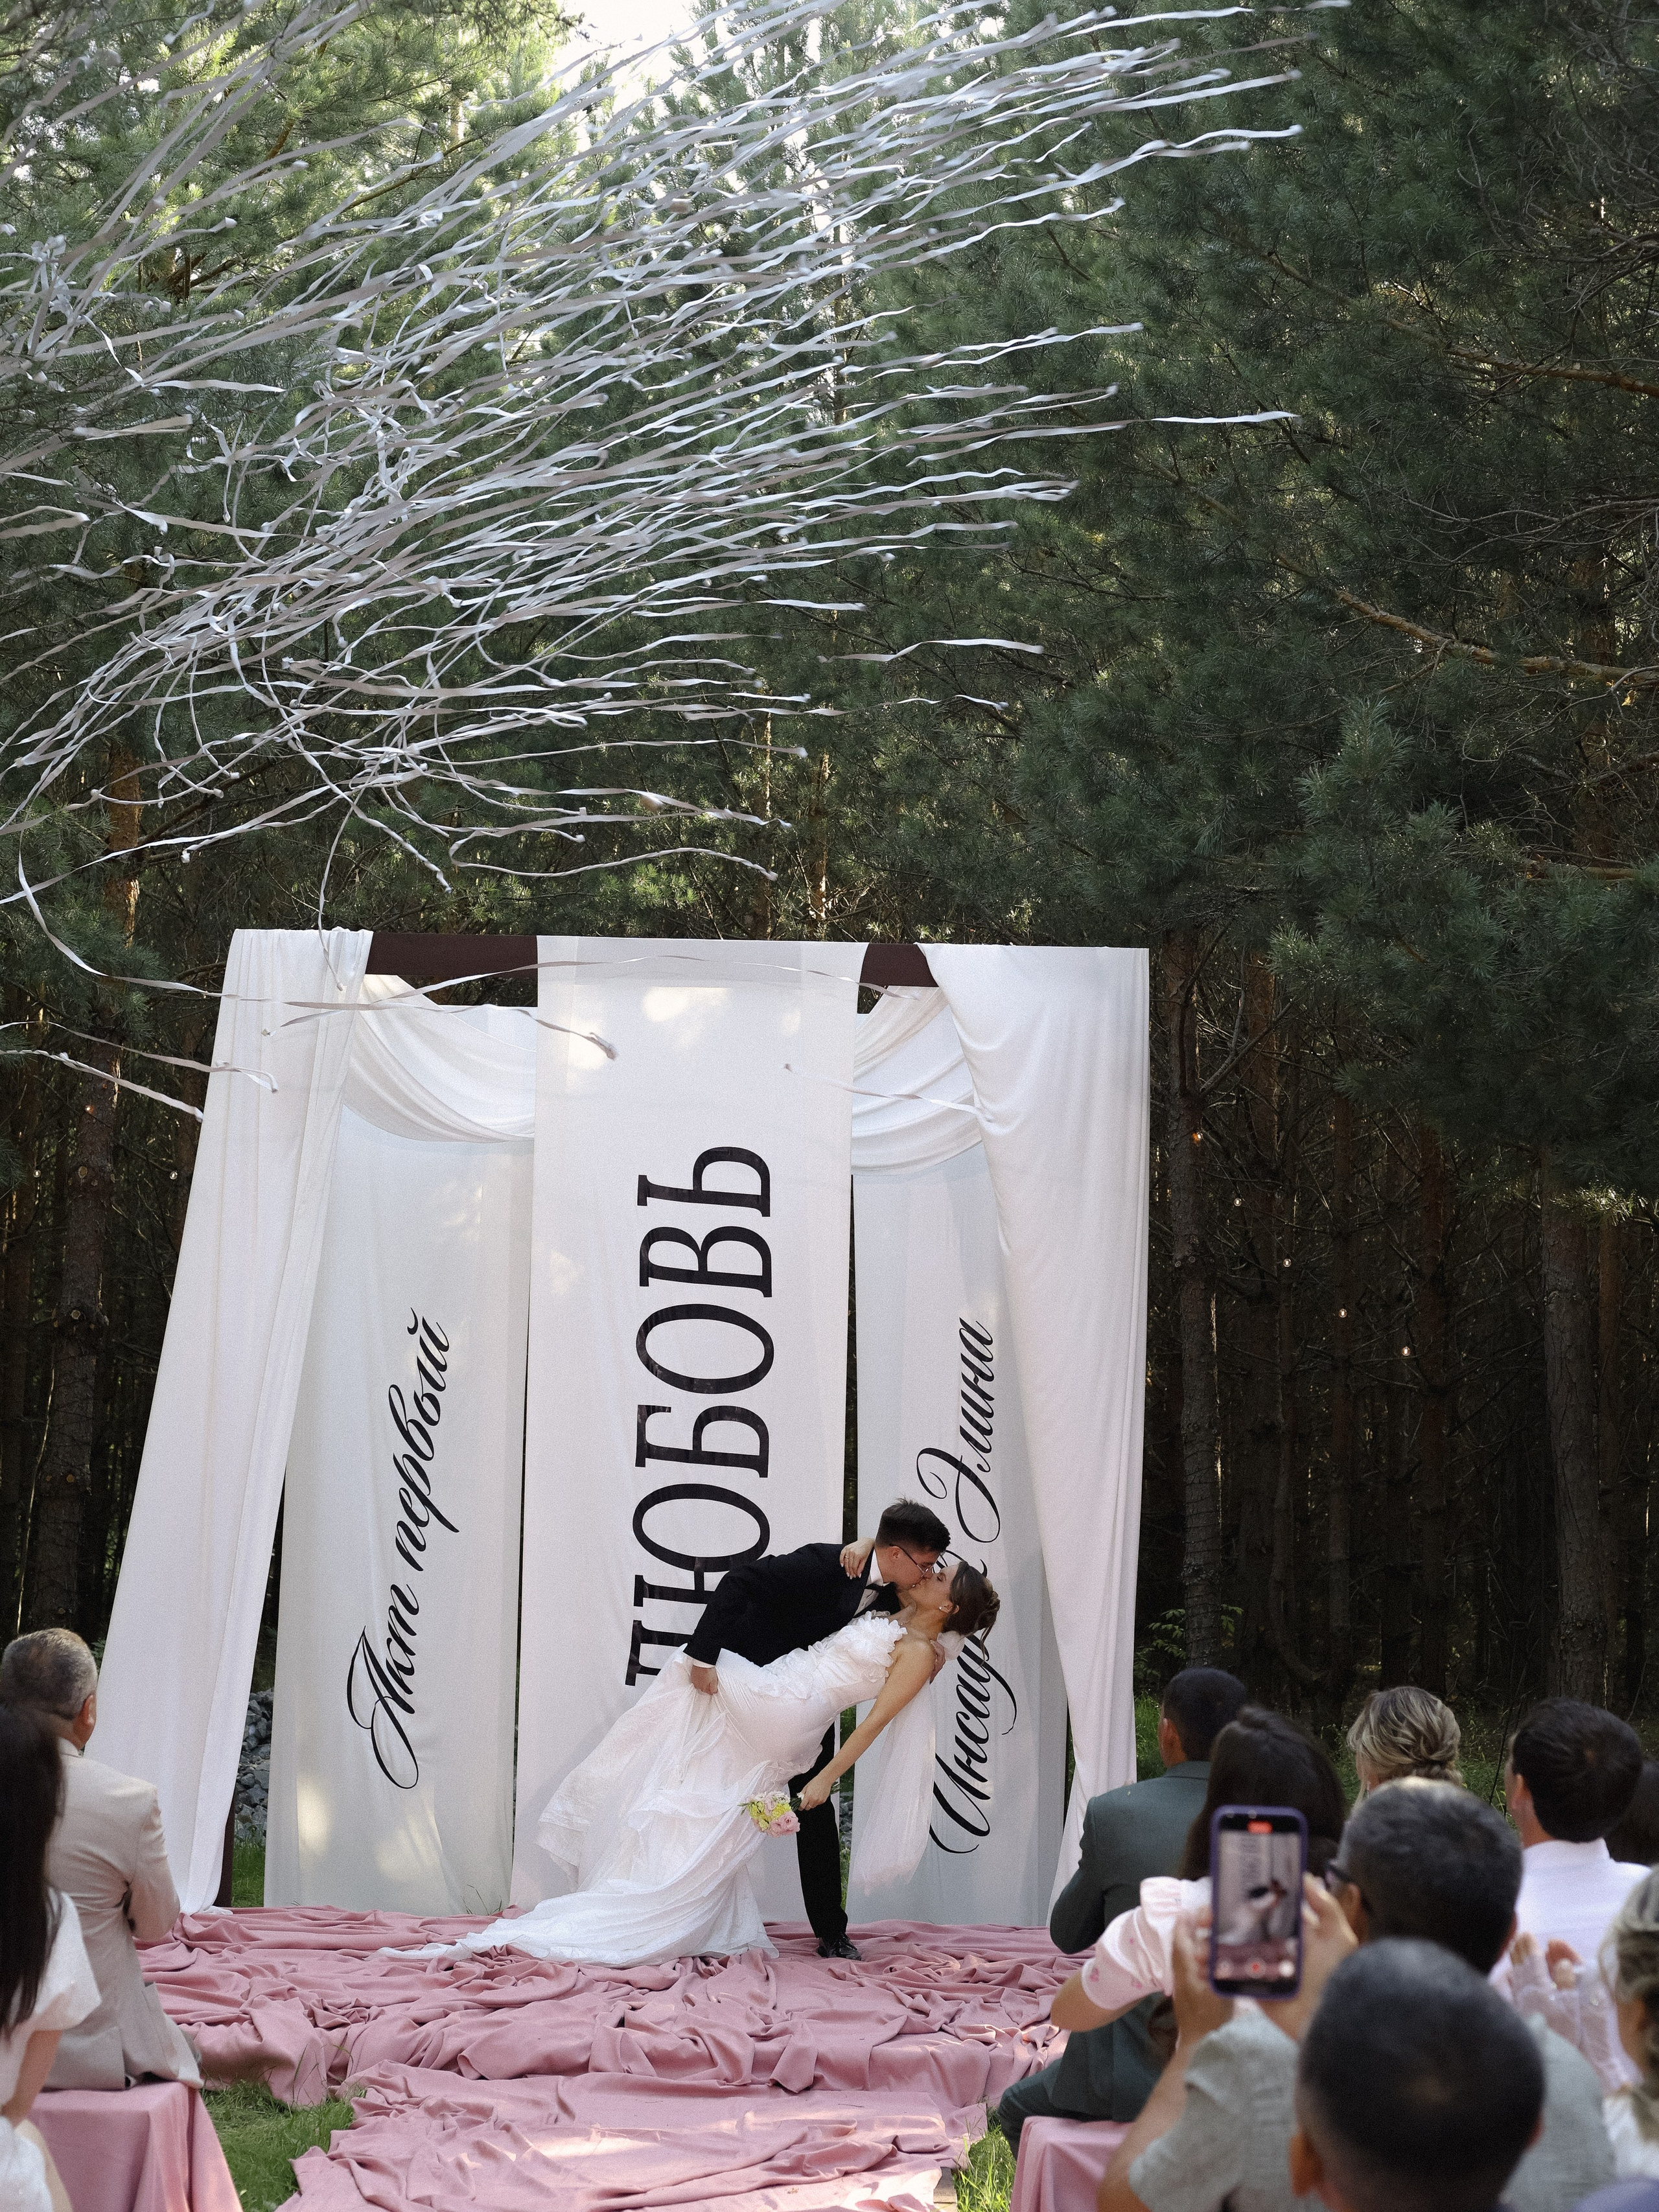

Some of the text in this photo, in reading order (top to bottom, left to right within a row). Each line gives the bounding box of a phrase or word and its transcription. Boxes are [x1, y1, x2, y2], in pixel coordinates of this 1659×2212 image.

[347, 1308, 459, 1789] Акт первый
[916, 1318, 1001, 1543] Элина
